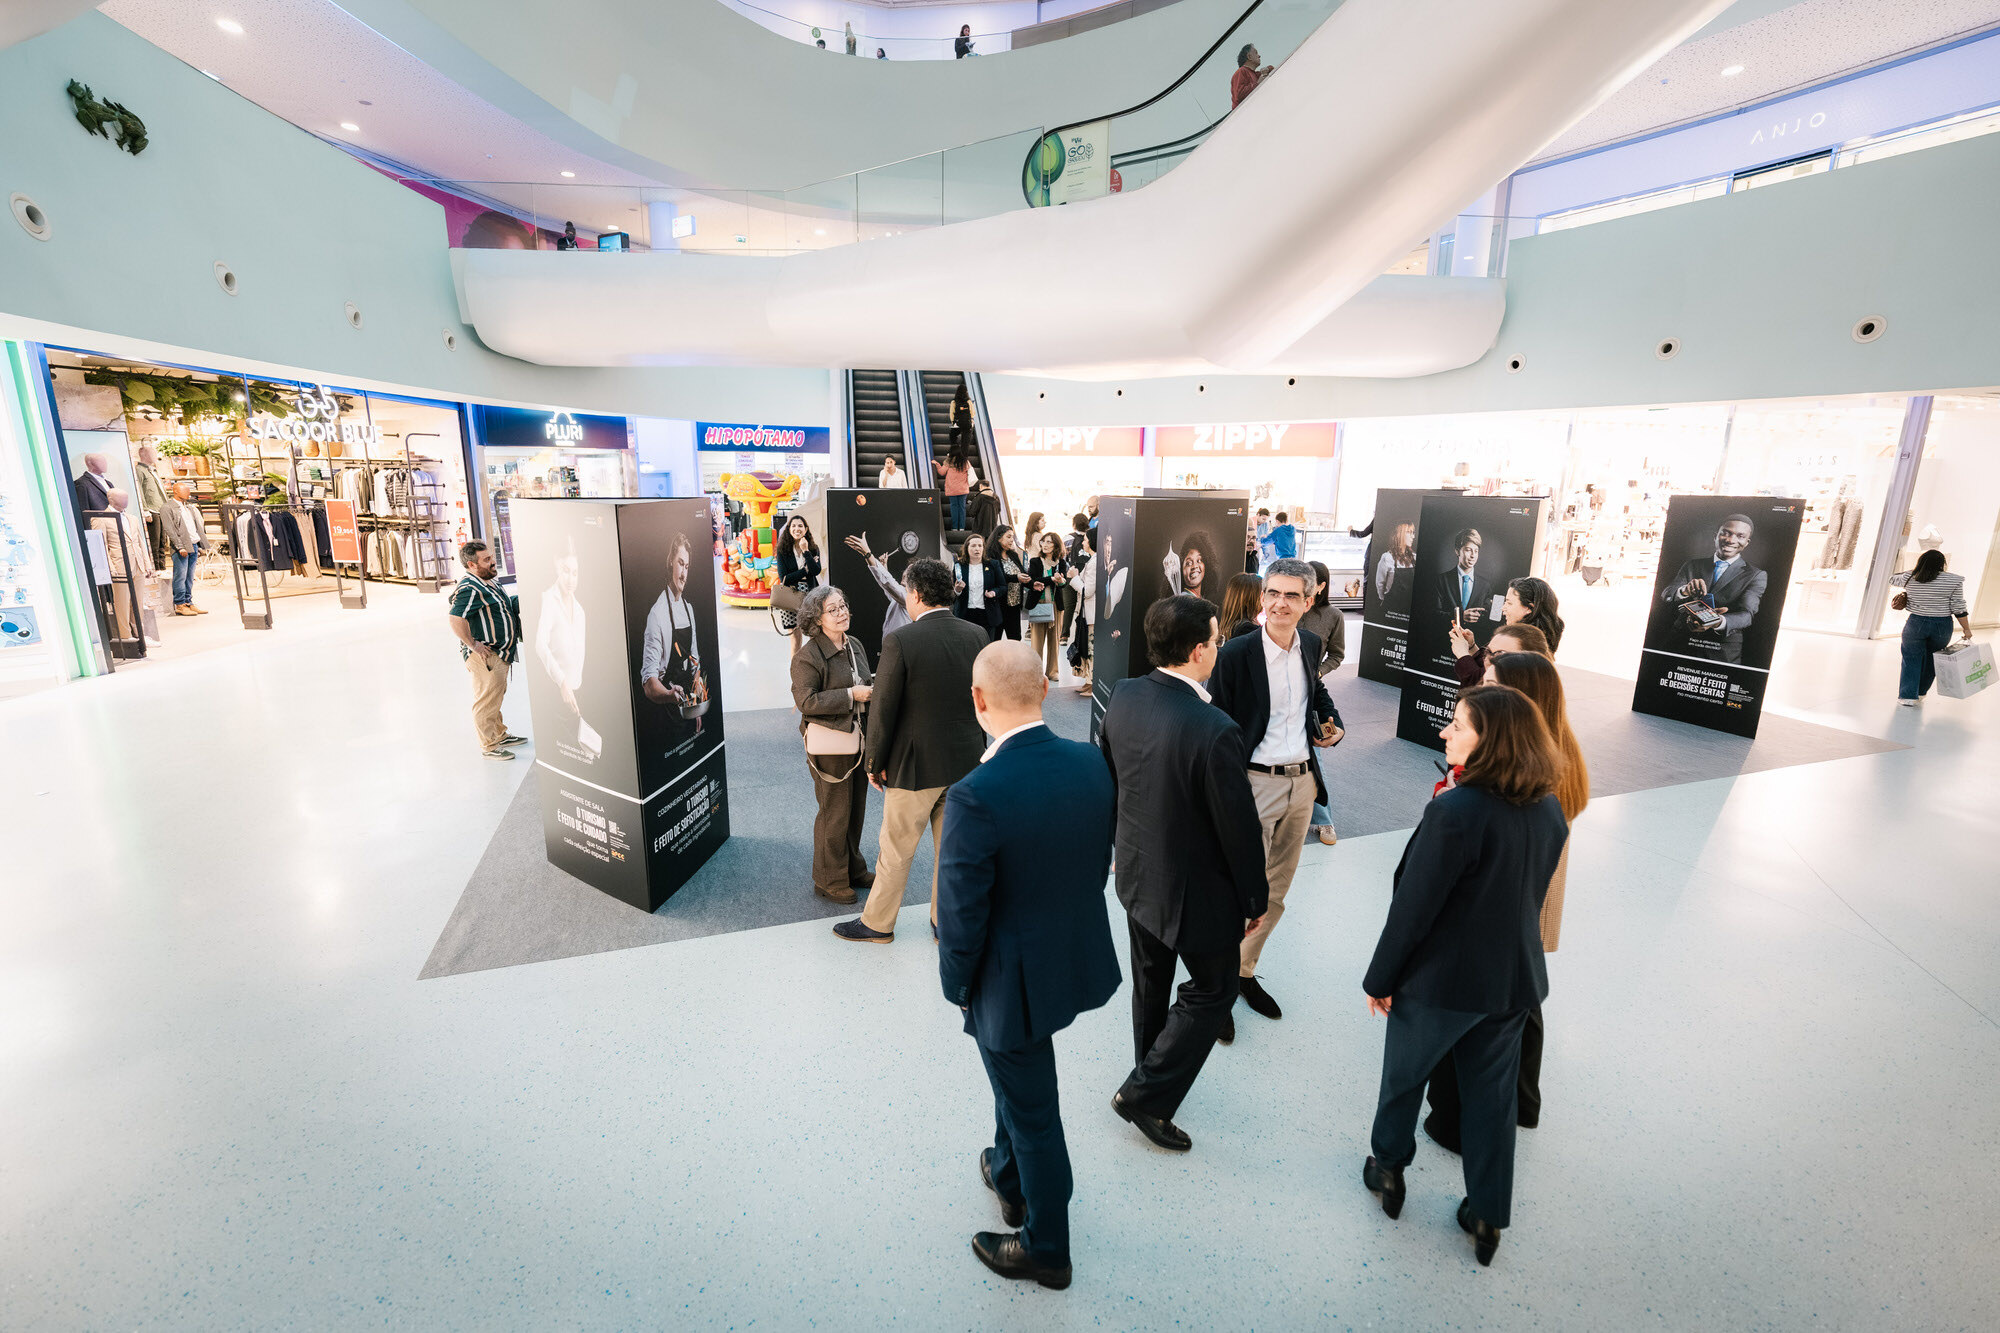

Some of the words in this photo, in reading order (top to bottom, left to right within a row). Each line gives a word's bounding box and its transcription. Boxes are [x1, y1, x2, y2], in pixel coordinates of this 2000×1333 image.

[1750, 112, 1826, 144] ANJO
[1067, 145, 1086, 158] GO
[247, 417, 340, 443] SACOOR
[342, 425, 384, 444] BLUE
[545, 423, 584, 441] PLURI
[704, 424, 806, 447] HIPOPÓTAMO
[1015, 427, 1101, 451] ZIPPY
[1192, 424, 1291, 451] ZIPPY
[1380, 647, 1385, 656] É
[1384, 649, 1396, 658] FEITO
[1396, 652, 1402, 660] DE
[1667, 671, 1673, 679] O
[1673, 672, 1701, 685] TURISMO
[1702, 677, 1707, 687] É
[1707, 680, 1727, 690] FEITO
[1677, 666, 1701, 675] REVENUE
[1701, 670, 1729, 680] MANAGER
[1420, 680, 1437, 689] GESTOR
[1660, 678, 1668, 687] DE
[1669, 679, 1699, 694] DECISÕES
[1699, 686, 1726, 699] CERTAS
[1445, 700, 1450, 708] O
[1685, 693, 1709, 702] momento
[1416, 700, 1421, 710] É
[1420, 702, 1436, 714] FEITO
[1436, 706, 1443, 717] DE
[657, 794, 684, 818] COZINHEIRO
[683, 775, 708, 797] VEGETARIANO
[686, 799, 691, 812] O
[691, 784, 709, 808] TURISMO
[576, 806, 581, 819] O
[581, 809, 607, 829] TURISMO
[591, 802, 605, 813] SALA
[557, 808, 562, 822] É
[561, 812, 575, 829] FEITO
[575, 819, 583, 833] DE
[583, 821, 608, 843] CUIDADO
[653, 837, 659, 854] É
[658, 828, 674, 850] FEITO
[673, 821, 681, 836] DE
[680, 797, 710, 832] SOFISTICAÇÃO
[563, 836, 574, 846] cada
[591, 850, 610, 863] especial
[586, 840, 595, 850] que
[596, 844, 609, 855] torna
